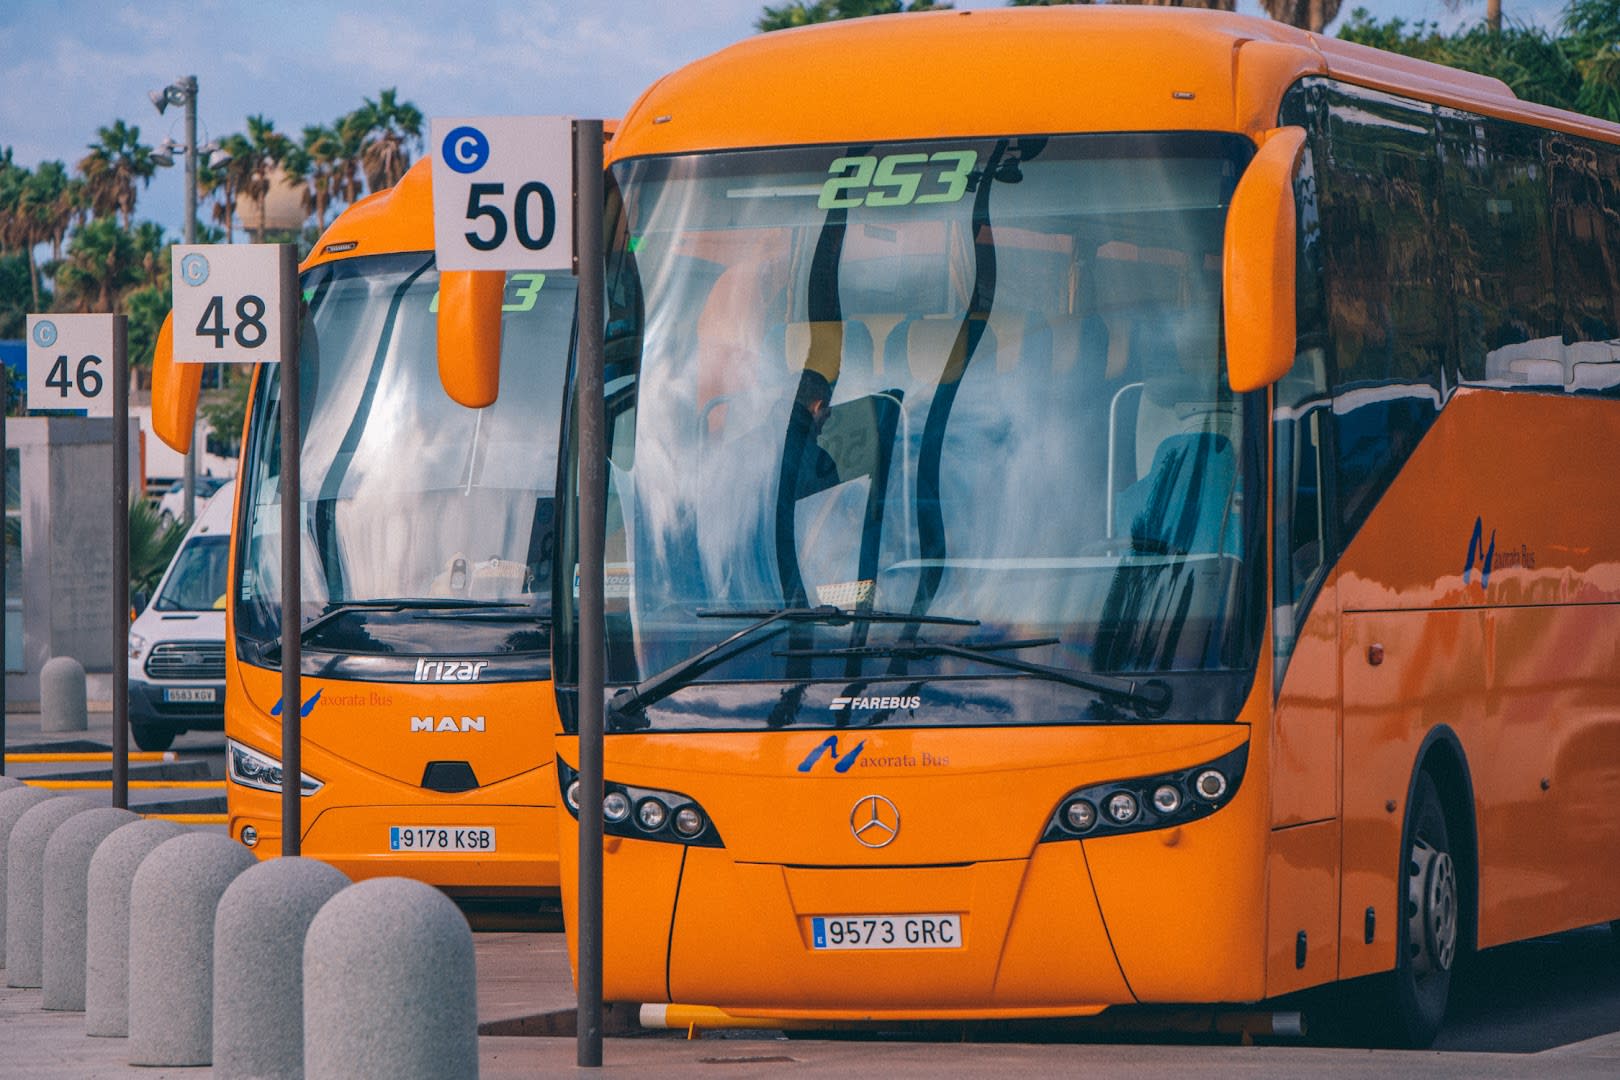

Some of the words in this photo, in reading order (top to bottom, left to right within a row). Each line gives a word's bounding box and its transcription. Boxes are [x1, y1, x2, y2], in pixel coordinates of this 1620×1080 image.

[455, 136, 479, 165] C
[817, 150, 978, 209] 253
[464, 181, 556, 251] 50
[188, 260, 202, 280] C
[195, 295, 267, 349] 48
[40, 326, 51, 342] C
[45, 354, 103, 398] 46
[414, 657, 489, 681] Irizar
[369, 692, 393, 707] Bus
[851, 696, 921, 710] FAREBUS
[410, 716, 485, 732] MAN
[921, 752, 950, 768] Bus
[403, 829, 448, 848] 9178
[455, 830, 490, 848] KSB
[829, 920, 895, 944] 9573
[905, 919, 953, 944] GRC
